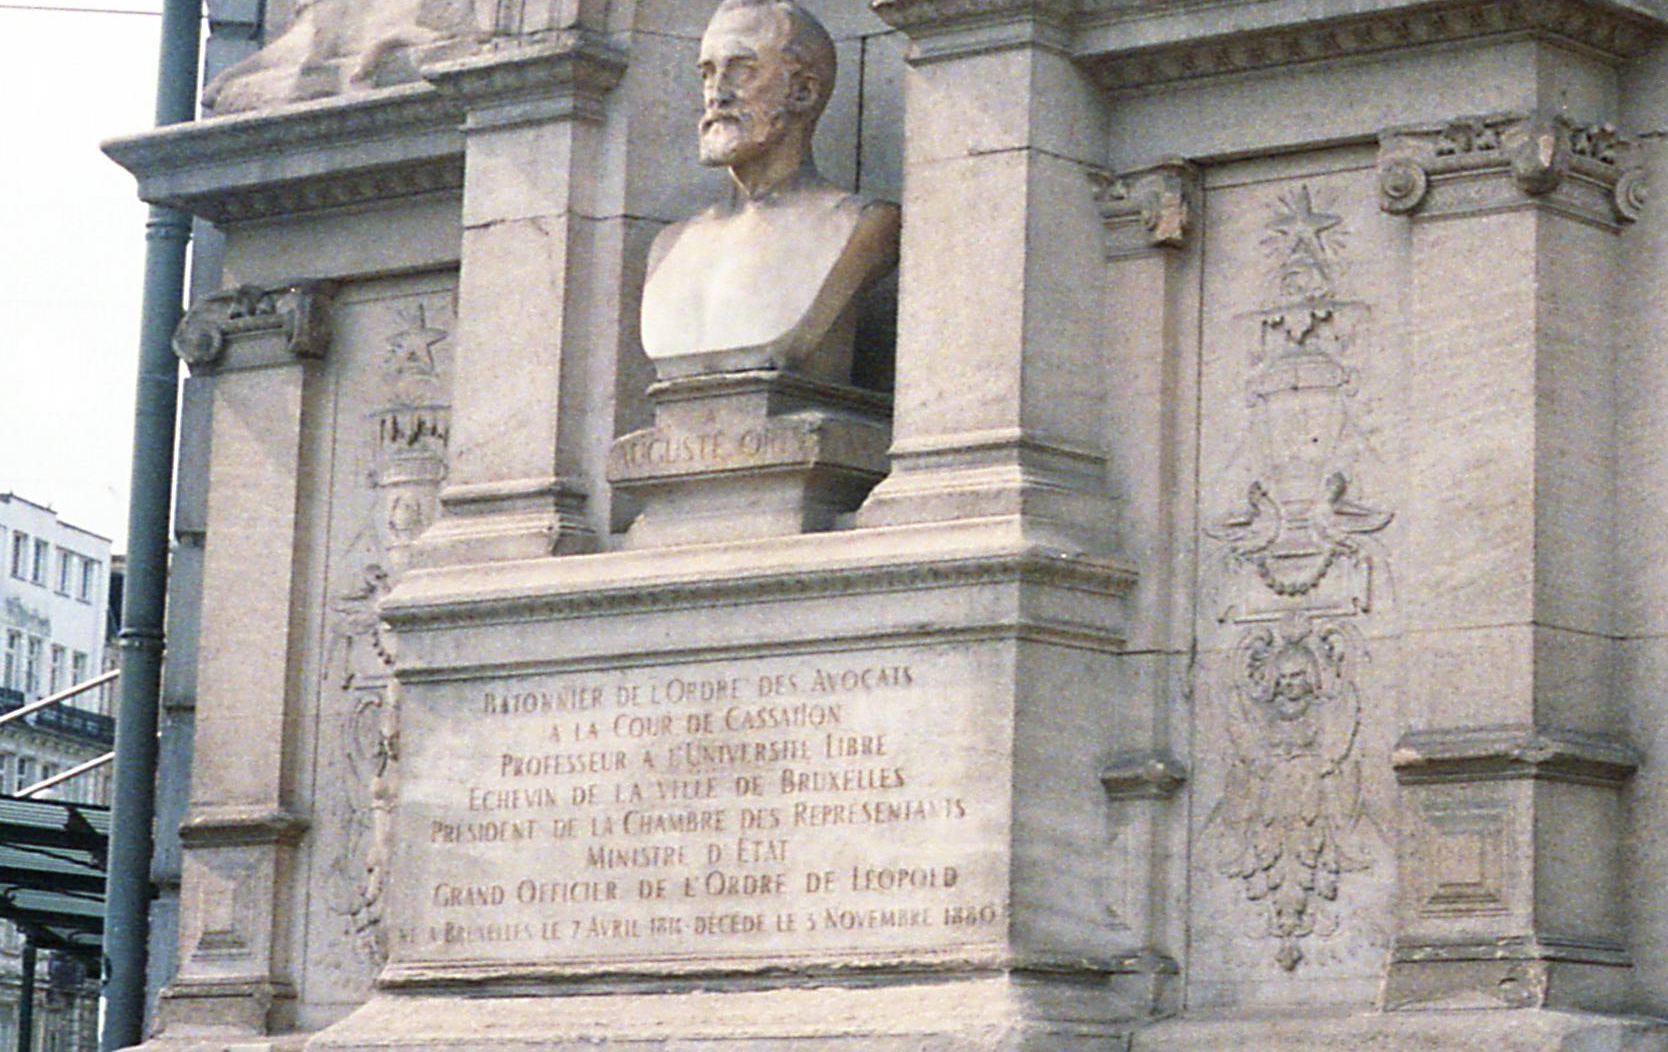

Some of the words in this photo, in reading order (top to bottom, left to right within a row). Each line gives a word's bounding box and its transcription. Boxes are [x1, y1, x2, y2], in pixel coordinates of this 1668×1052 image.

[617, 685, 641, 708] DE
[758, 674, 797, 698] DES
[811, 665, 913, 694] AVOCATS
[613, 713, 673, 739] COUR
[687, 712, 713, 735] DE
[725, 702, 842, 732] CASSATION
[501, 751, 627, 777] PROFESSEUR
[826, 733, 887, 760] LIBRE
[572, 784, 600, 806] DE
[615, 782, 643, 804] LA
[657, 777, 718, 801] VILLE
[736, 776, 764, 797] DE
[781, 767, 906, 795] BRUXELLES
[553, 817, 578, 839] DE
[592, 816, 613, 837] LA
[623, 808, 726, 836] CHAMBRE
[741, 806, 780, 831] DES
[587, 845, 685, 870] MINISTRE
[433, 883, 505, 907] GRAND
[517, 879, 618, 904] OFFICIER
[639, 878, 667, 900] DE
[806, 871, 835, 894] DE
[541, 922, 560, 940] LE
[572, 921, 580, 940] 7
[586, 915, 640, 939] AVRIL
[776, 913, 795, 933] LE
[824, 907, 931, 931] NOVEMBRE
